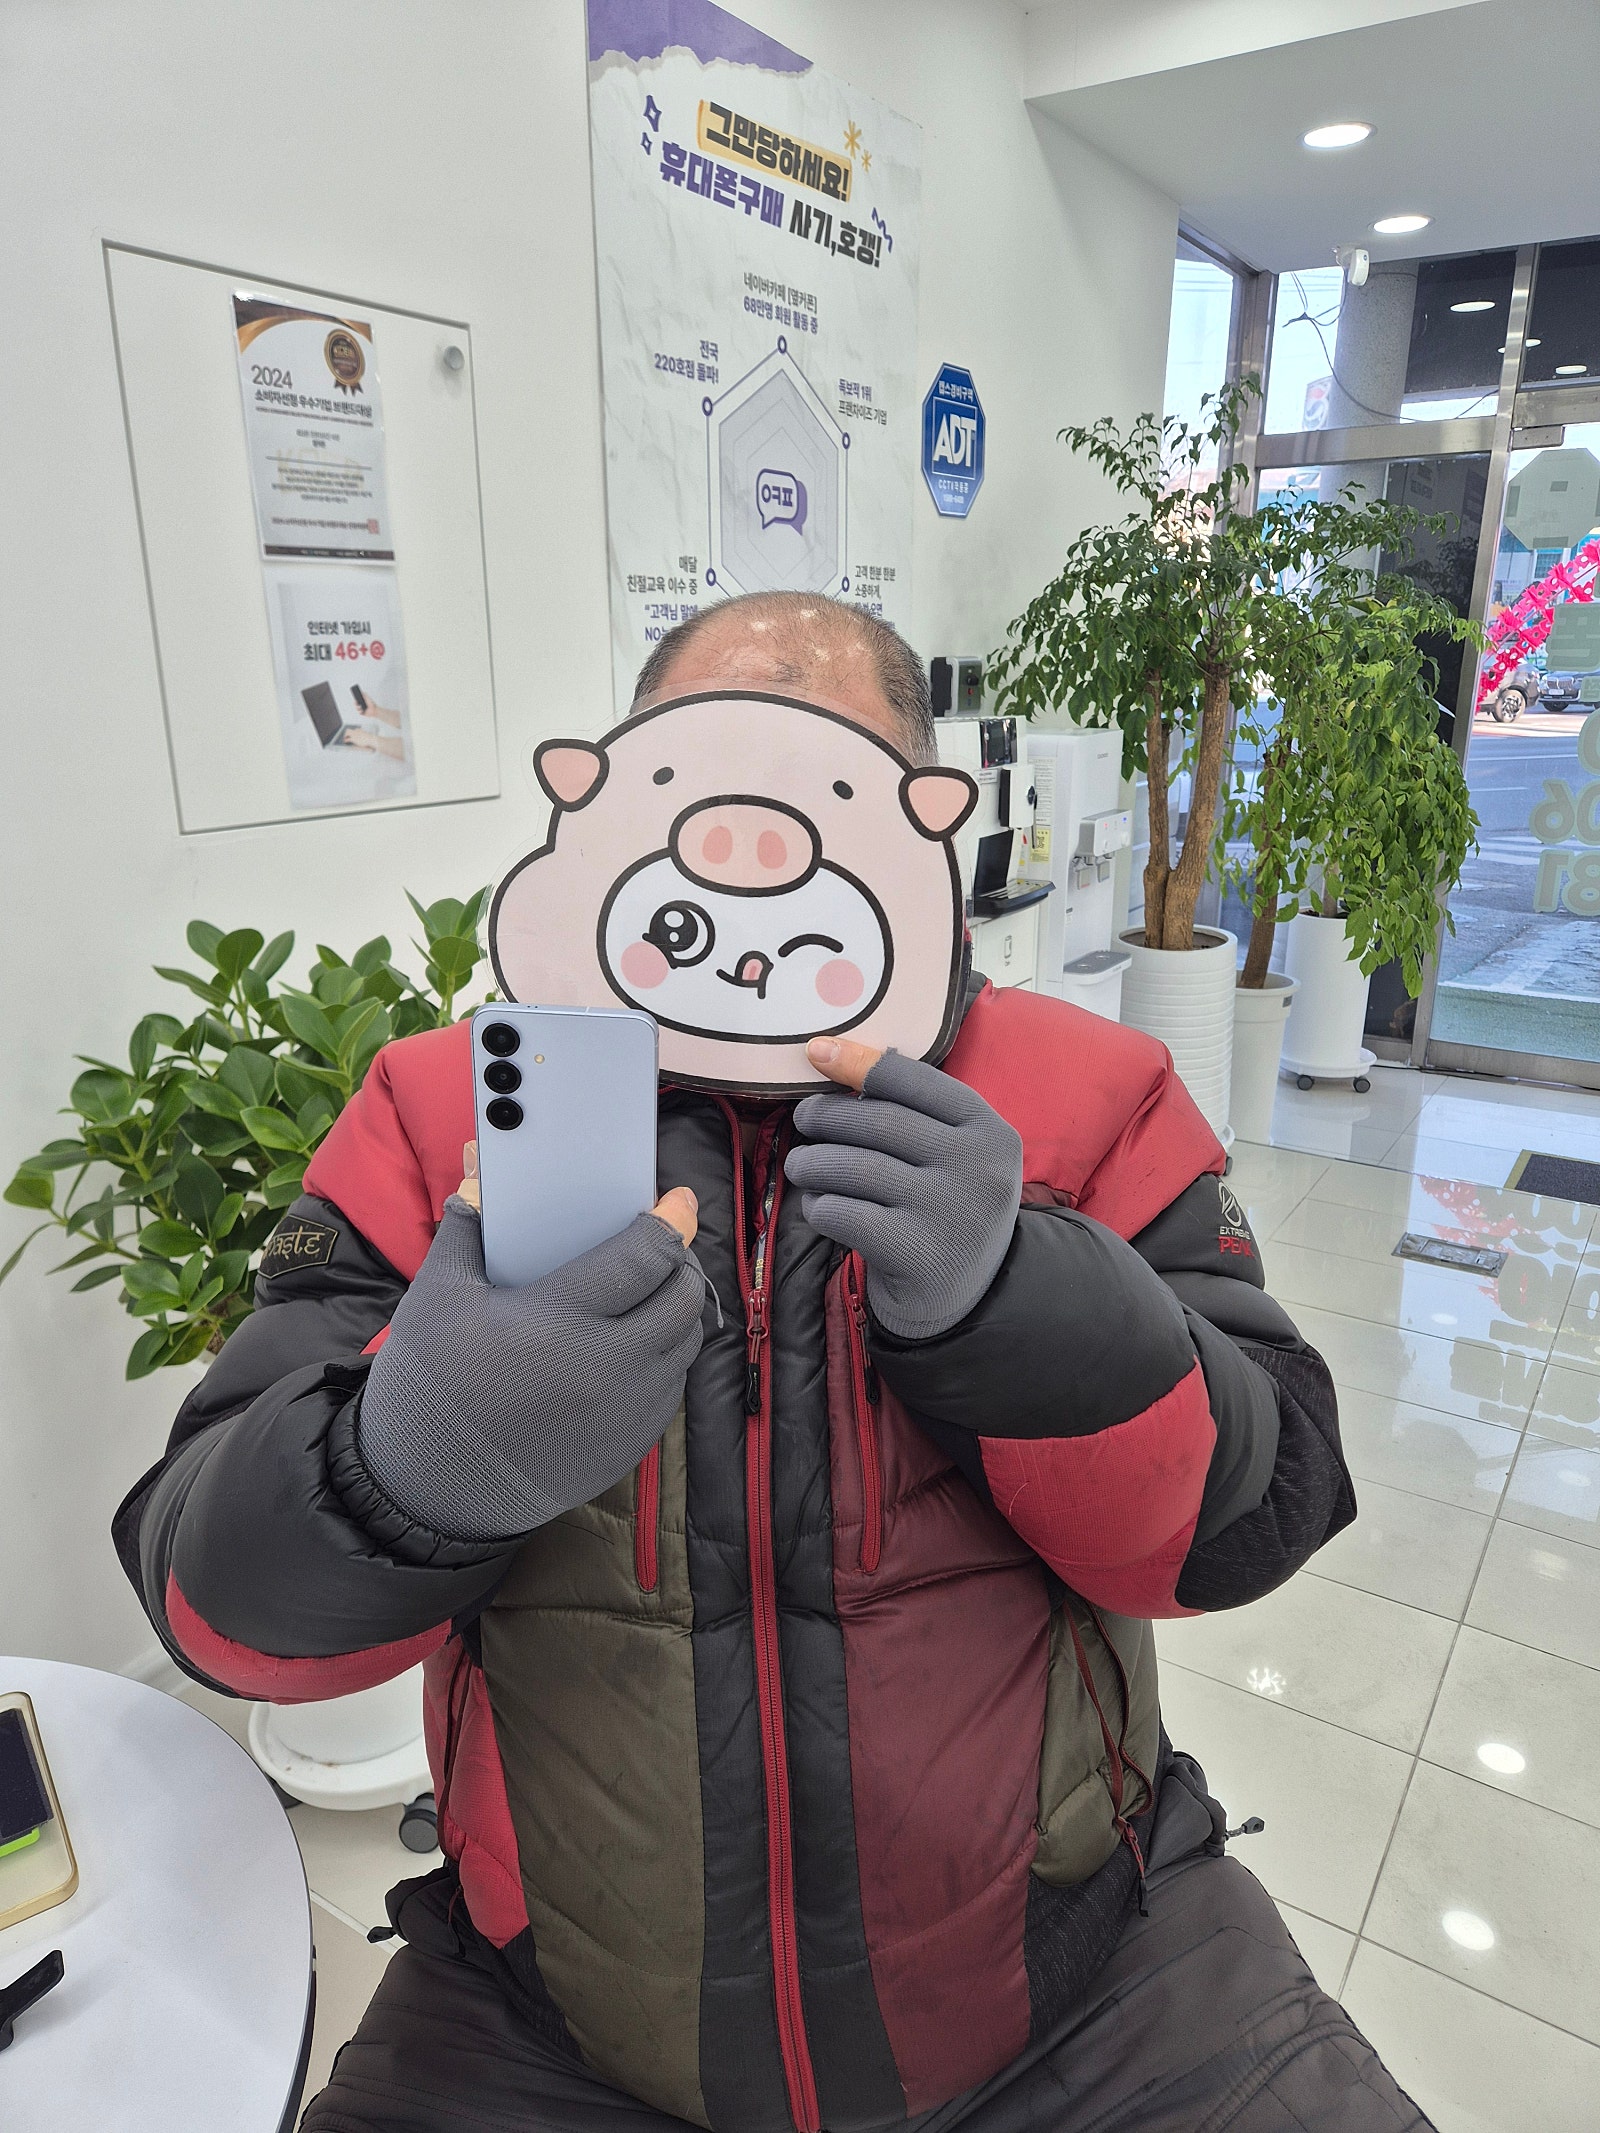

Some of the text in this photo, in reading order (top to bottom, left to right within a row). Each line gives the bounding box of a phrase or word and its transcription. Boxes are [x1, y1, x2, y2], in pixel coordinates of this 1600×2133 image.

[706, 101, 850, 202] 그만당하세요!
[660, 141, 882, 268] 휴대폰구매 사기,호갱!
[743, 272, 786, 303] 네이버카페
[743, 295, 818, 335] 68만명 회원 활동 중
[700, 340, 718, 362] 전국
[251, 364, 293, 389] 2024
[654, 352, 719, 384] 220호점 돌파!
[839, 378, 872, 402] 독보적 1위
[874, 408, 887, 425] 기업
[932, 413, 977, 467] ADT
[679, 555, 697, 573] 매달
[855, 565, 896, 581] 고객 한분 한분
[627, 574, 697, 595] 친절교육 이수 중
[307, 621, 371, 635] 인터넷 가입시
[303, 640, 385, 661] 최대 46+@
[1219, 1226, 1251, 1240] EXTREME
